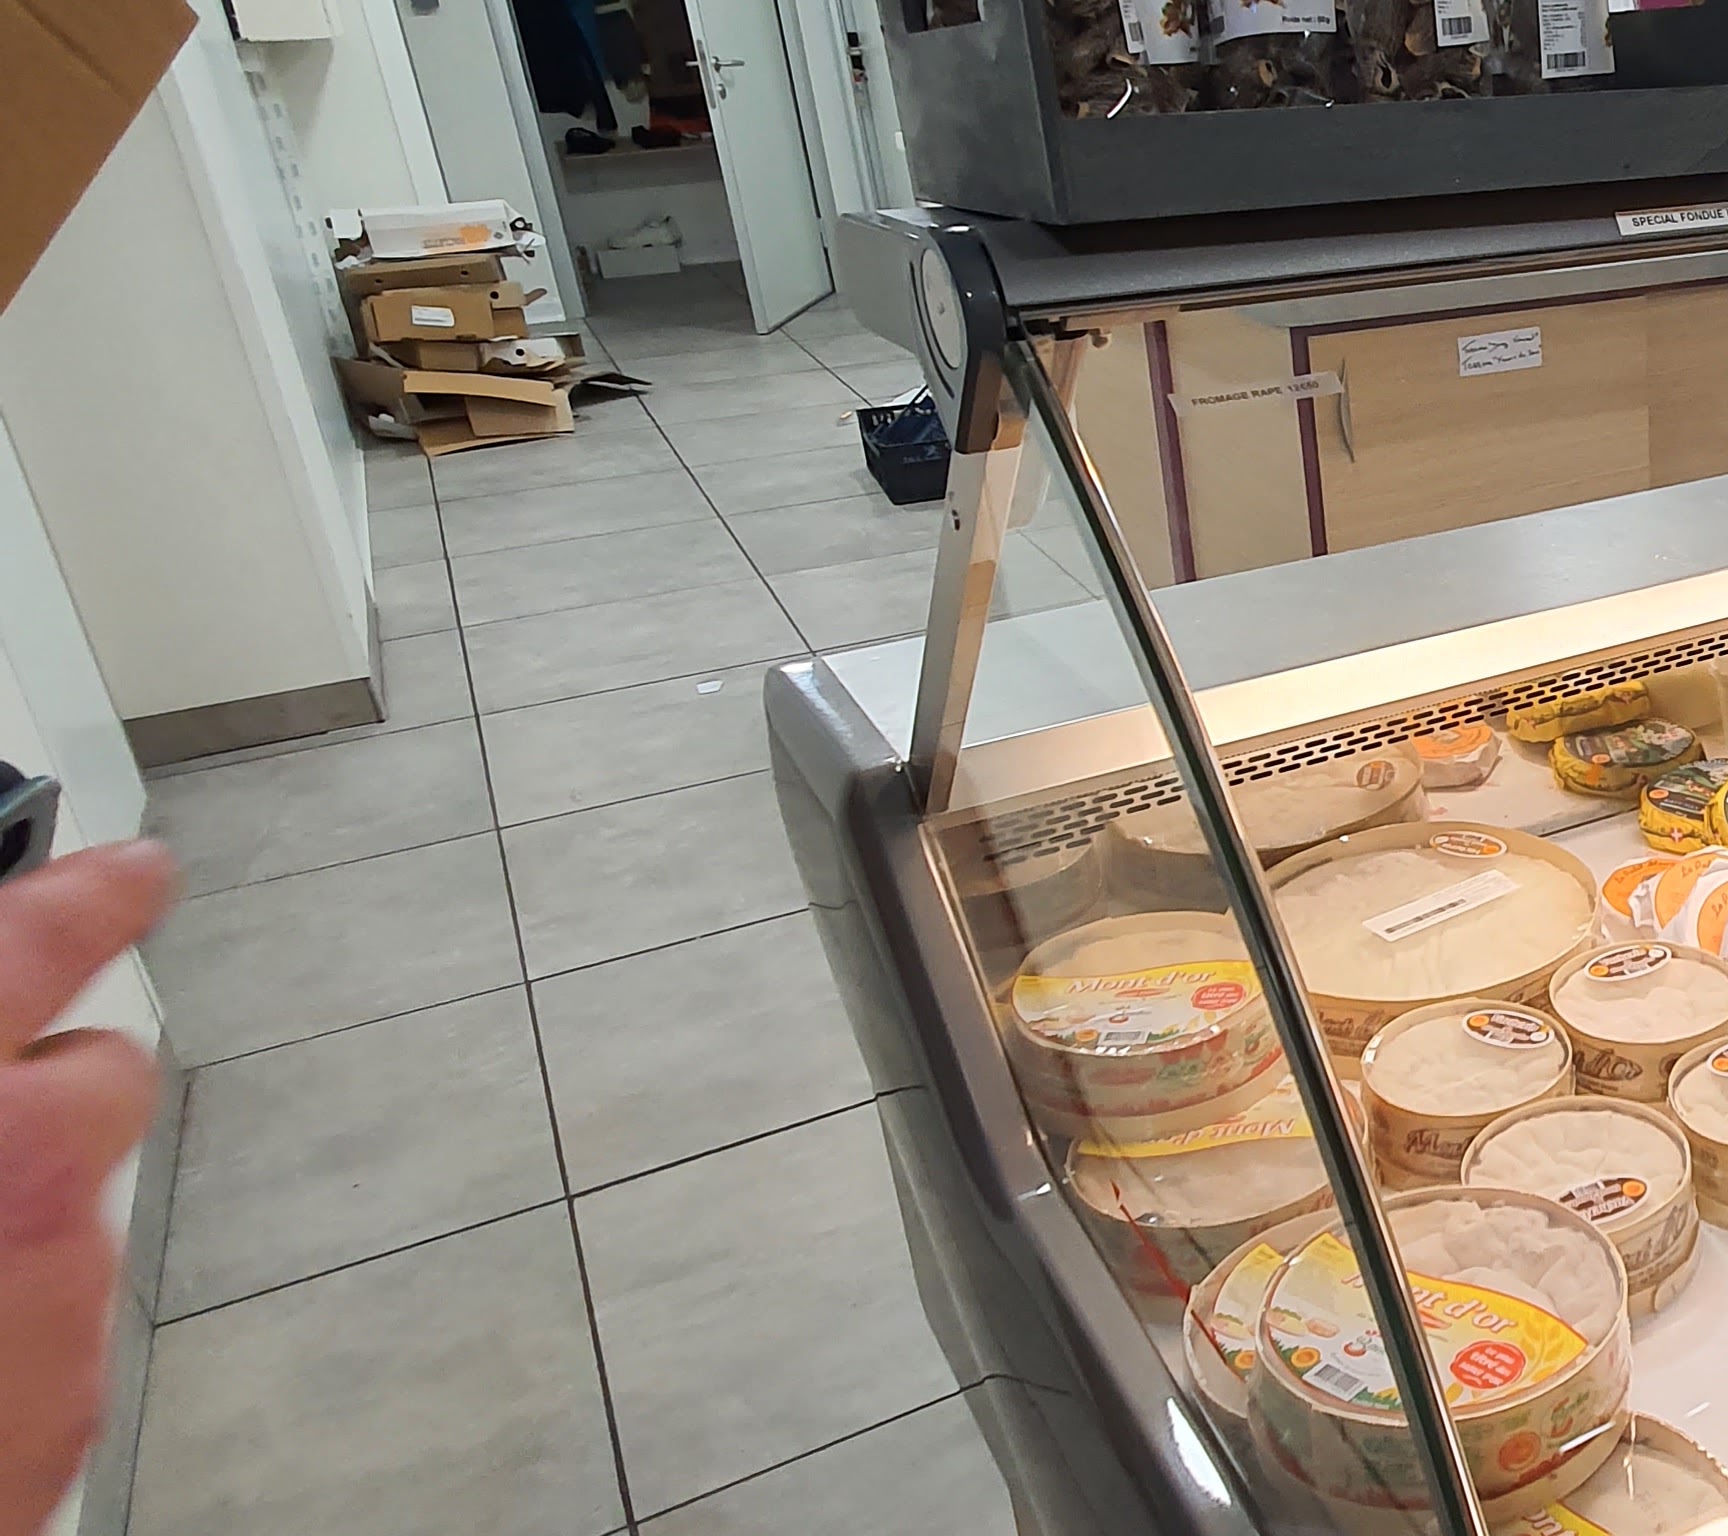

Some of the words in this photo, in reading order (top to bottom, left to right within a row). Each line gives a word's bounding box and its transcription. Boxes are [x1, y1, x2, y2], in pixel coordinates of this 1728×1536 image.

[1631, 213, 1678, 227] SPECIAL
[1680, 208, 1724, 222] FONDUE
[1191, 391, 1249, 407] FROMAGE
[1250, 386, 1283, 399] RAPE
[1067, 976, 1150, 994] Mont
[1154, 970, 1218, 986] d'or
[1443, 1299, 1517, 1334] d'or
